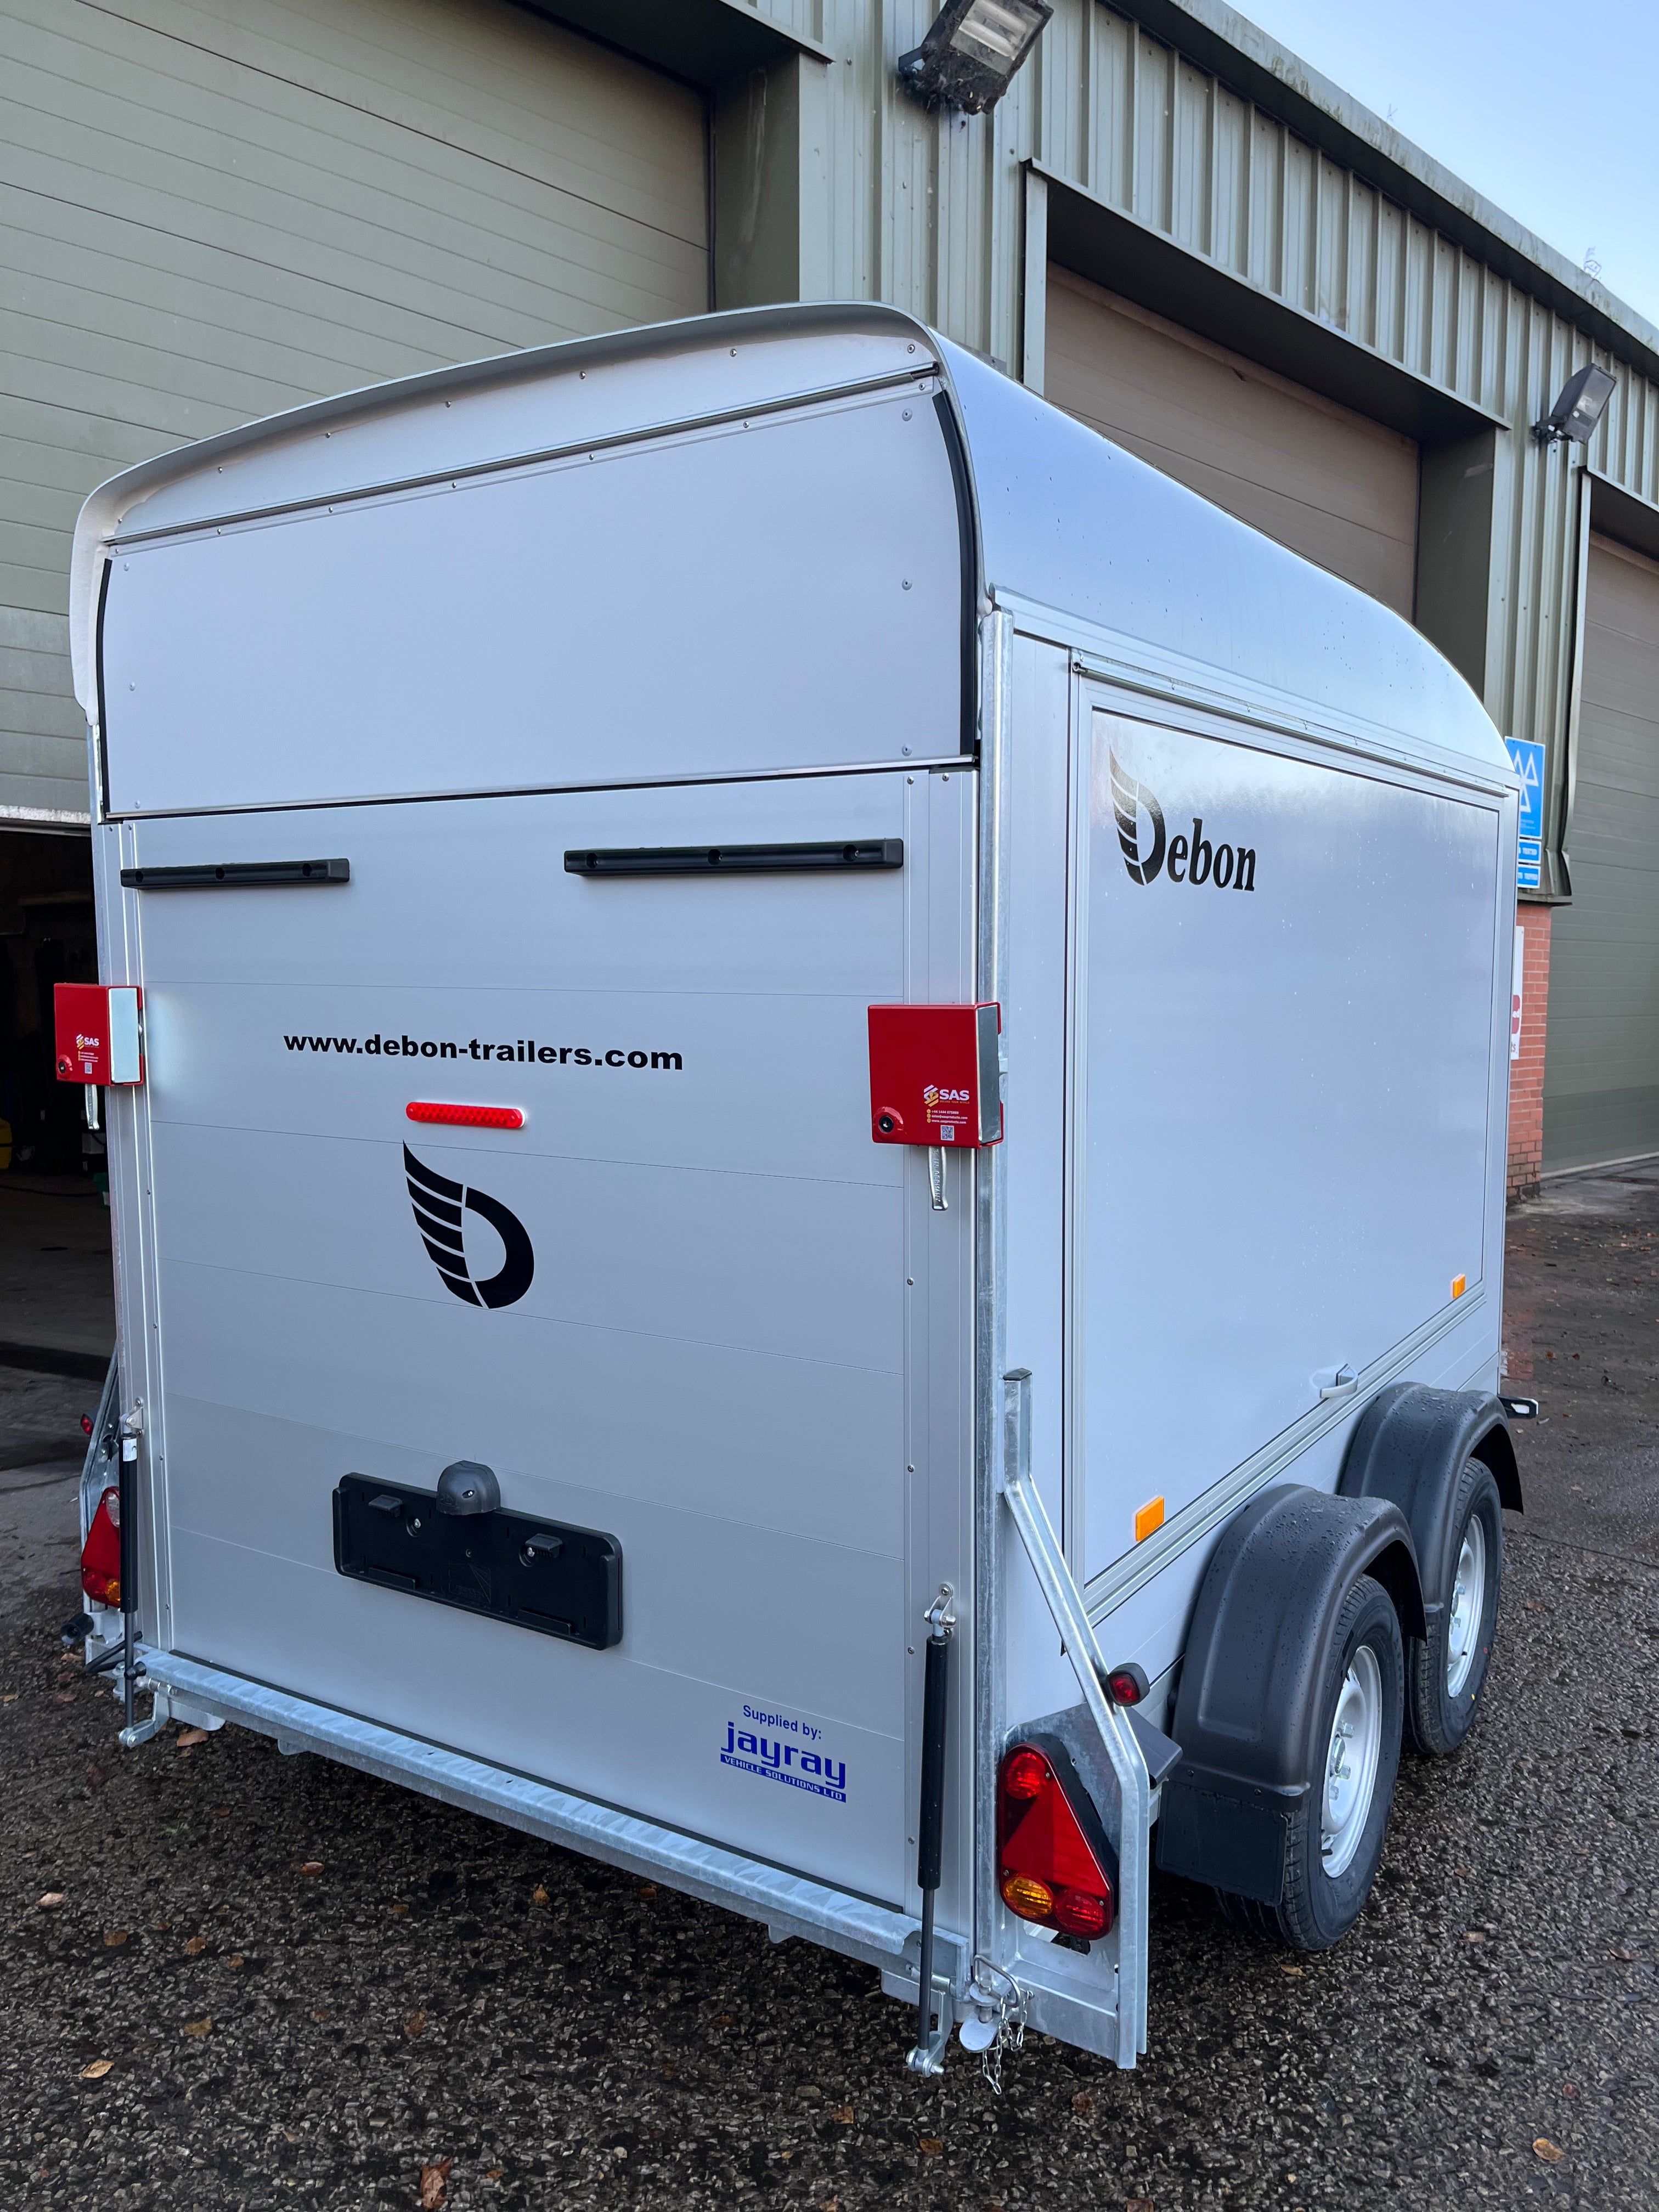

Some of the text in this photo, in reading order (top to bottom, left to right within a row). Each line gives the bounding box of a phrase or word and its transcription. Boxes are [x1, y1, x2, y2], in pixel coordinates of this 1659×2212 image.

[1109, 745, 1256, 892] Debon
[84, 1037, 99, 1046] SAS
[284, 1034, 683, 1070] www.debon-trailers.com
[939, 1089, 969, 1101] SAS
[743, 1705, 822, 1741] Supplied by:
[720, 1720, 846, 1790] jayray
[724, 1756, 843, 1801] VEHICLE SOLUTIONS LTD
